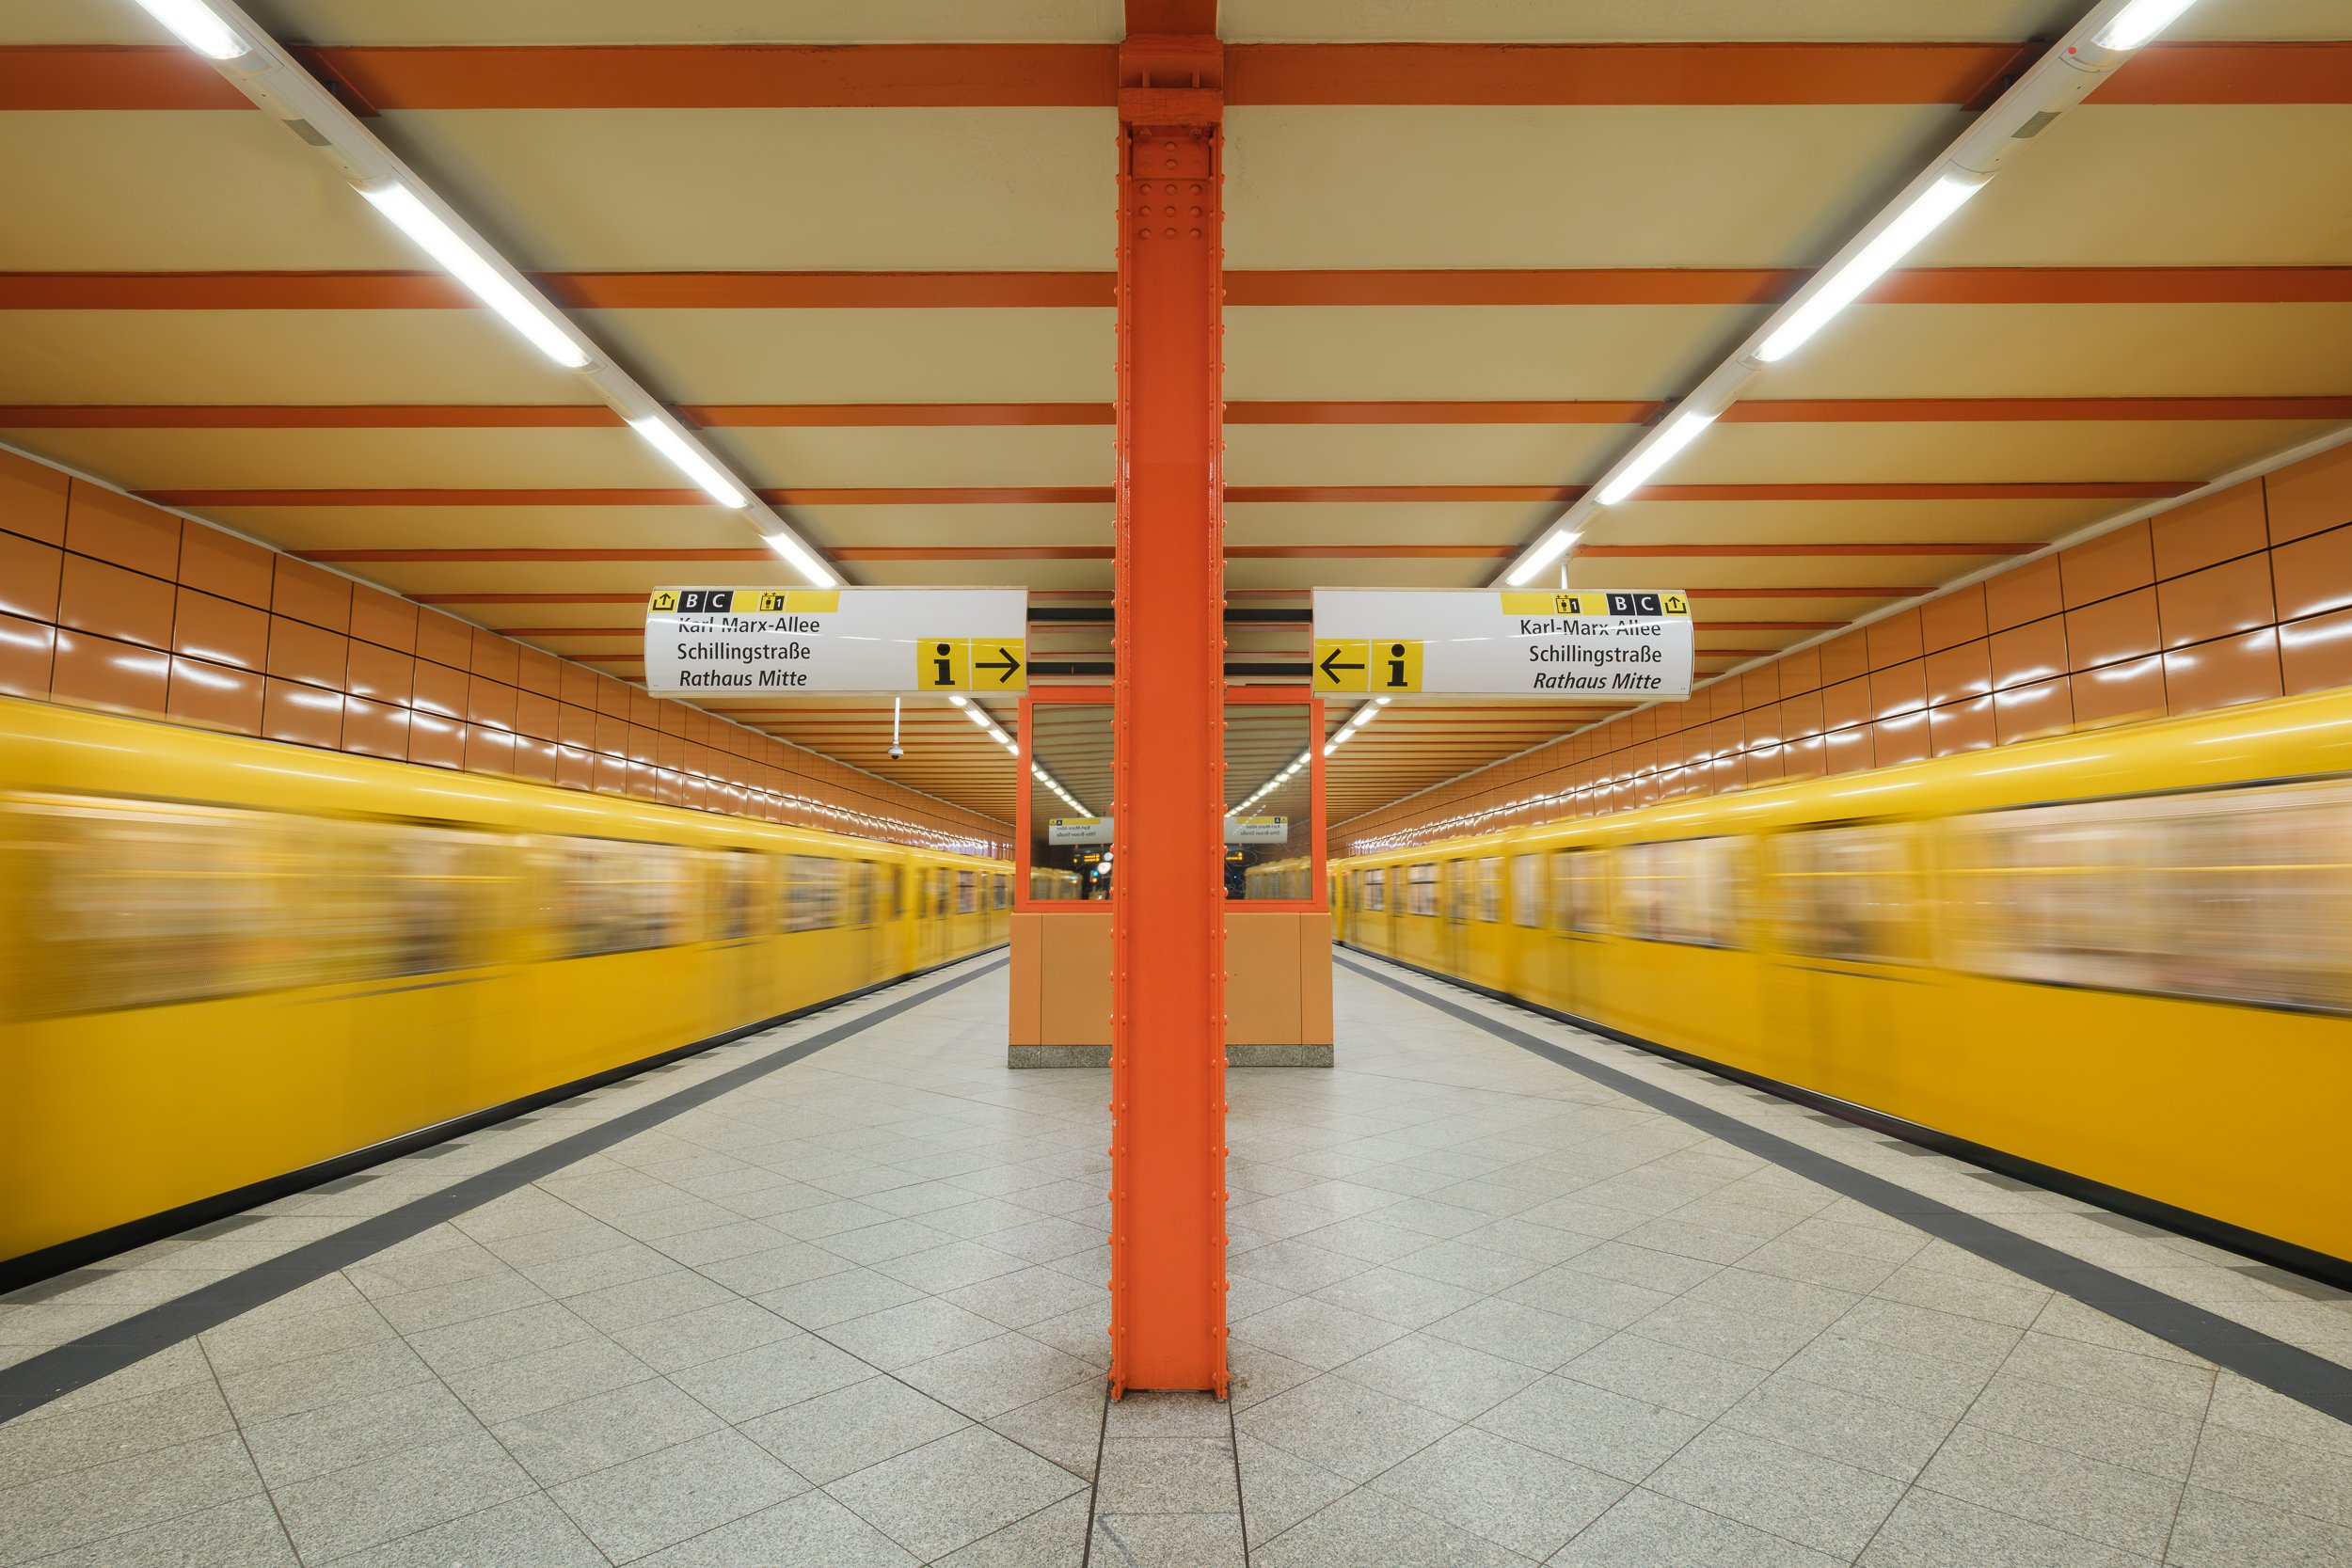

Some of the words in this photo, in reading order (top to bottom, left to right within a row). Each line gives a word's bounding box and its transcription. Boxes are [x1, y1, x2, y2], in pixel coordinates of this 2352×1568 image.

[686, 594, 698, 608] B
[712, 594, 725, 608] C
[776, 598, 782, 608] 1
[1571, 601, 1578, 610] 1
[1614, 596, 1628, 610] B
[1641, 596, 1654, 610] C
[678, 616, 820, 633] KarlMarx-Allee
[1520, 619, 1661, 636] Karl-MarxAllee
[677, 641, 811, 664] Schillingstraße
[1529, 644, 1662, 667] Schillingstraße
[679, 669, 753, 687] Rathaus
[758, 669, 807, 687] Mitte
[1533, 672, 1607, 689] Rathaus
[1612, 673, 1661, 689] Mitte
